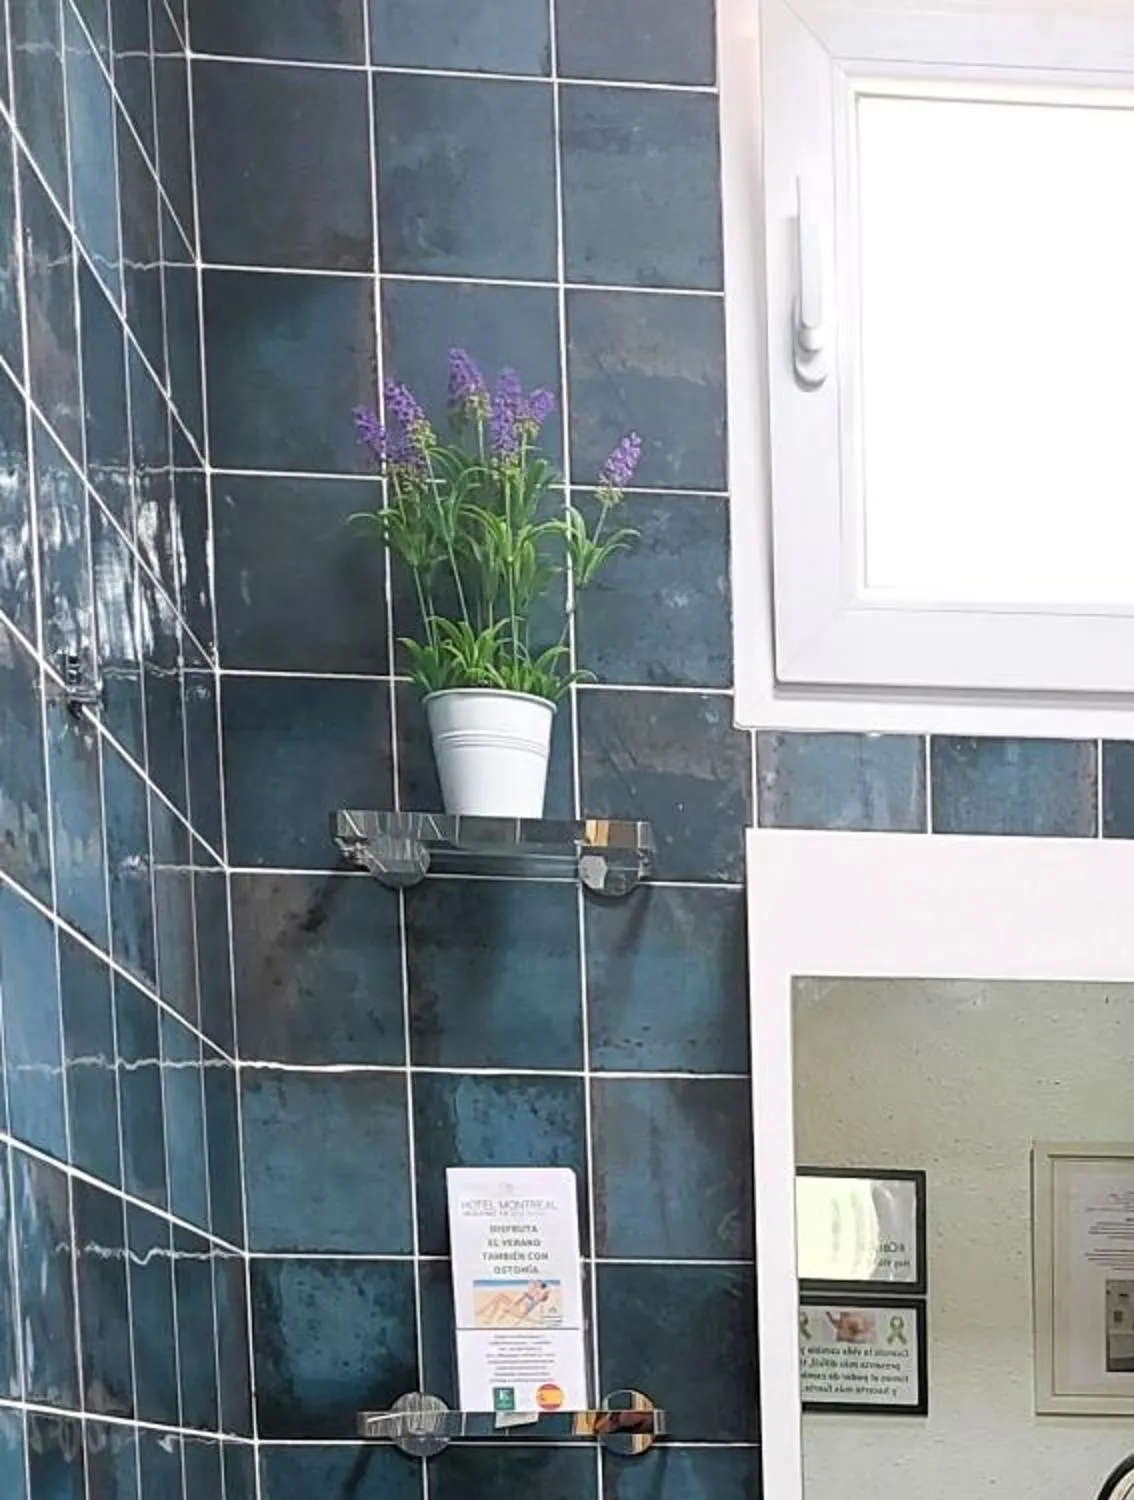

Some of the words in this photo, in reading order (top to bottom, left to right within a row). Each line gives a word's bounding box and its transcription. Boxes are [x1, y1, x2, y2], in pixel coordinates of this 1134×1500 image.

[489, 1225, 539, 1233] DISFRUTA
[487, 1239, 500, 1247] EL
[502, 1239, 541, 1247] VERANO
[482, 1251, 525, 1261] TAMBIÉN
[527, 1252, 549, 1260] CON
[493, 1264, 539, 1274] OSTOMÍA
